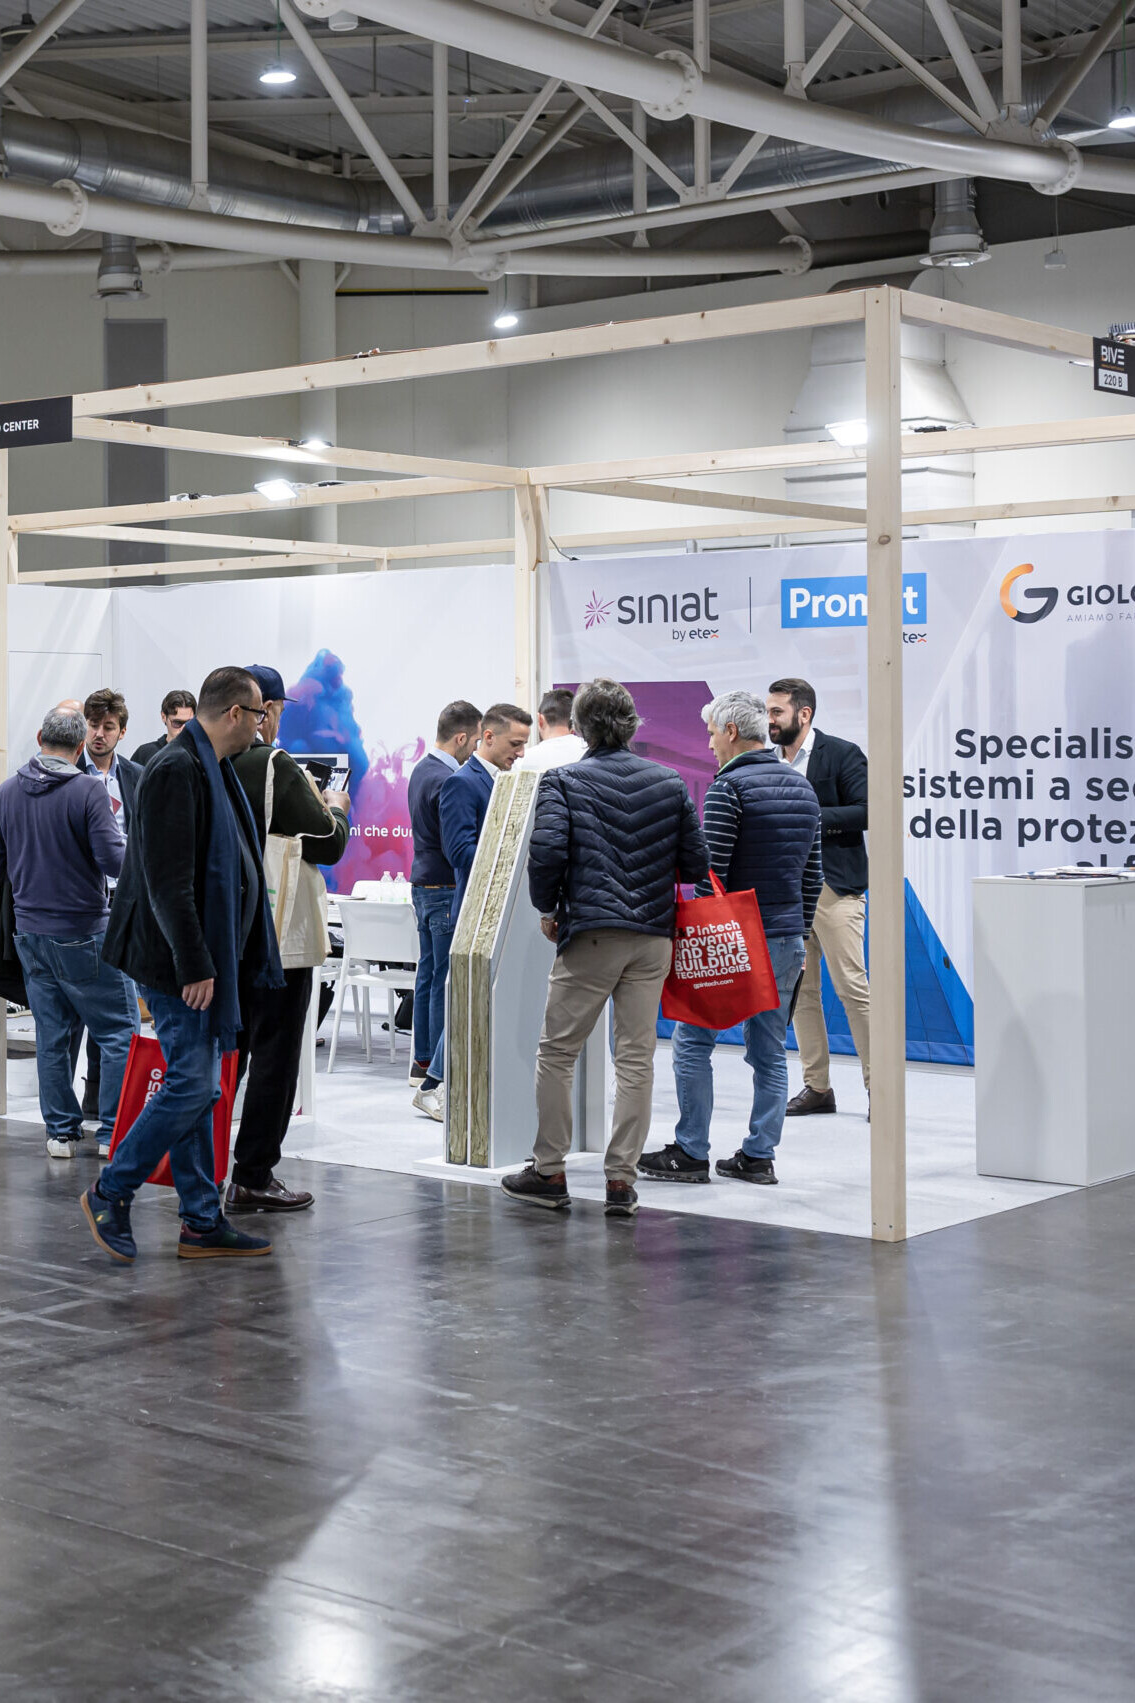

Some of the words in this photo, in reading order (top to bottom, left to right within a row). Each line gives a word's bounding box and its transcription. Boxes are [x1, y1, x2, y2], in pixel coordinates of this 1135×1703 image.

[1101, 345, 1124, 365] BIVE
[1104, 374, 1117, 386] 220
[1118, 376, 1123, 388] B
[2, 419, 40, 433] CENTER
[1067, 584, 1135, 606] GIOL
[617, 586, 719, 625] siniat
[1067, 613, 1114, 622] AMIAMO
[1119, 612, 1135, 621] FA
[672, 628, 686, 642] by
[688, 628, 719, 640] etex
[903, 632, 927, 644] tex
[954, 727, 1134, 765] Specialis
[903, 767, 1034, 800] sistemi
[1049, 776, 1070, 801] a
[1085, 776, 1135, 802] se
[364, 824, 389, 837] che
[909, 808, 1002, 841] della
[697, 919, 741, 936] intech
[675, 947, 703, 961] AND
[706, 940, 748, 958] SAFE
[674, 951, 749, 972] BUILDING
[675, 963, 752, 980] TECHNOLOGIES
[693, 978, 734, 990] gpintech.com
